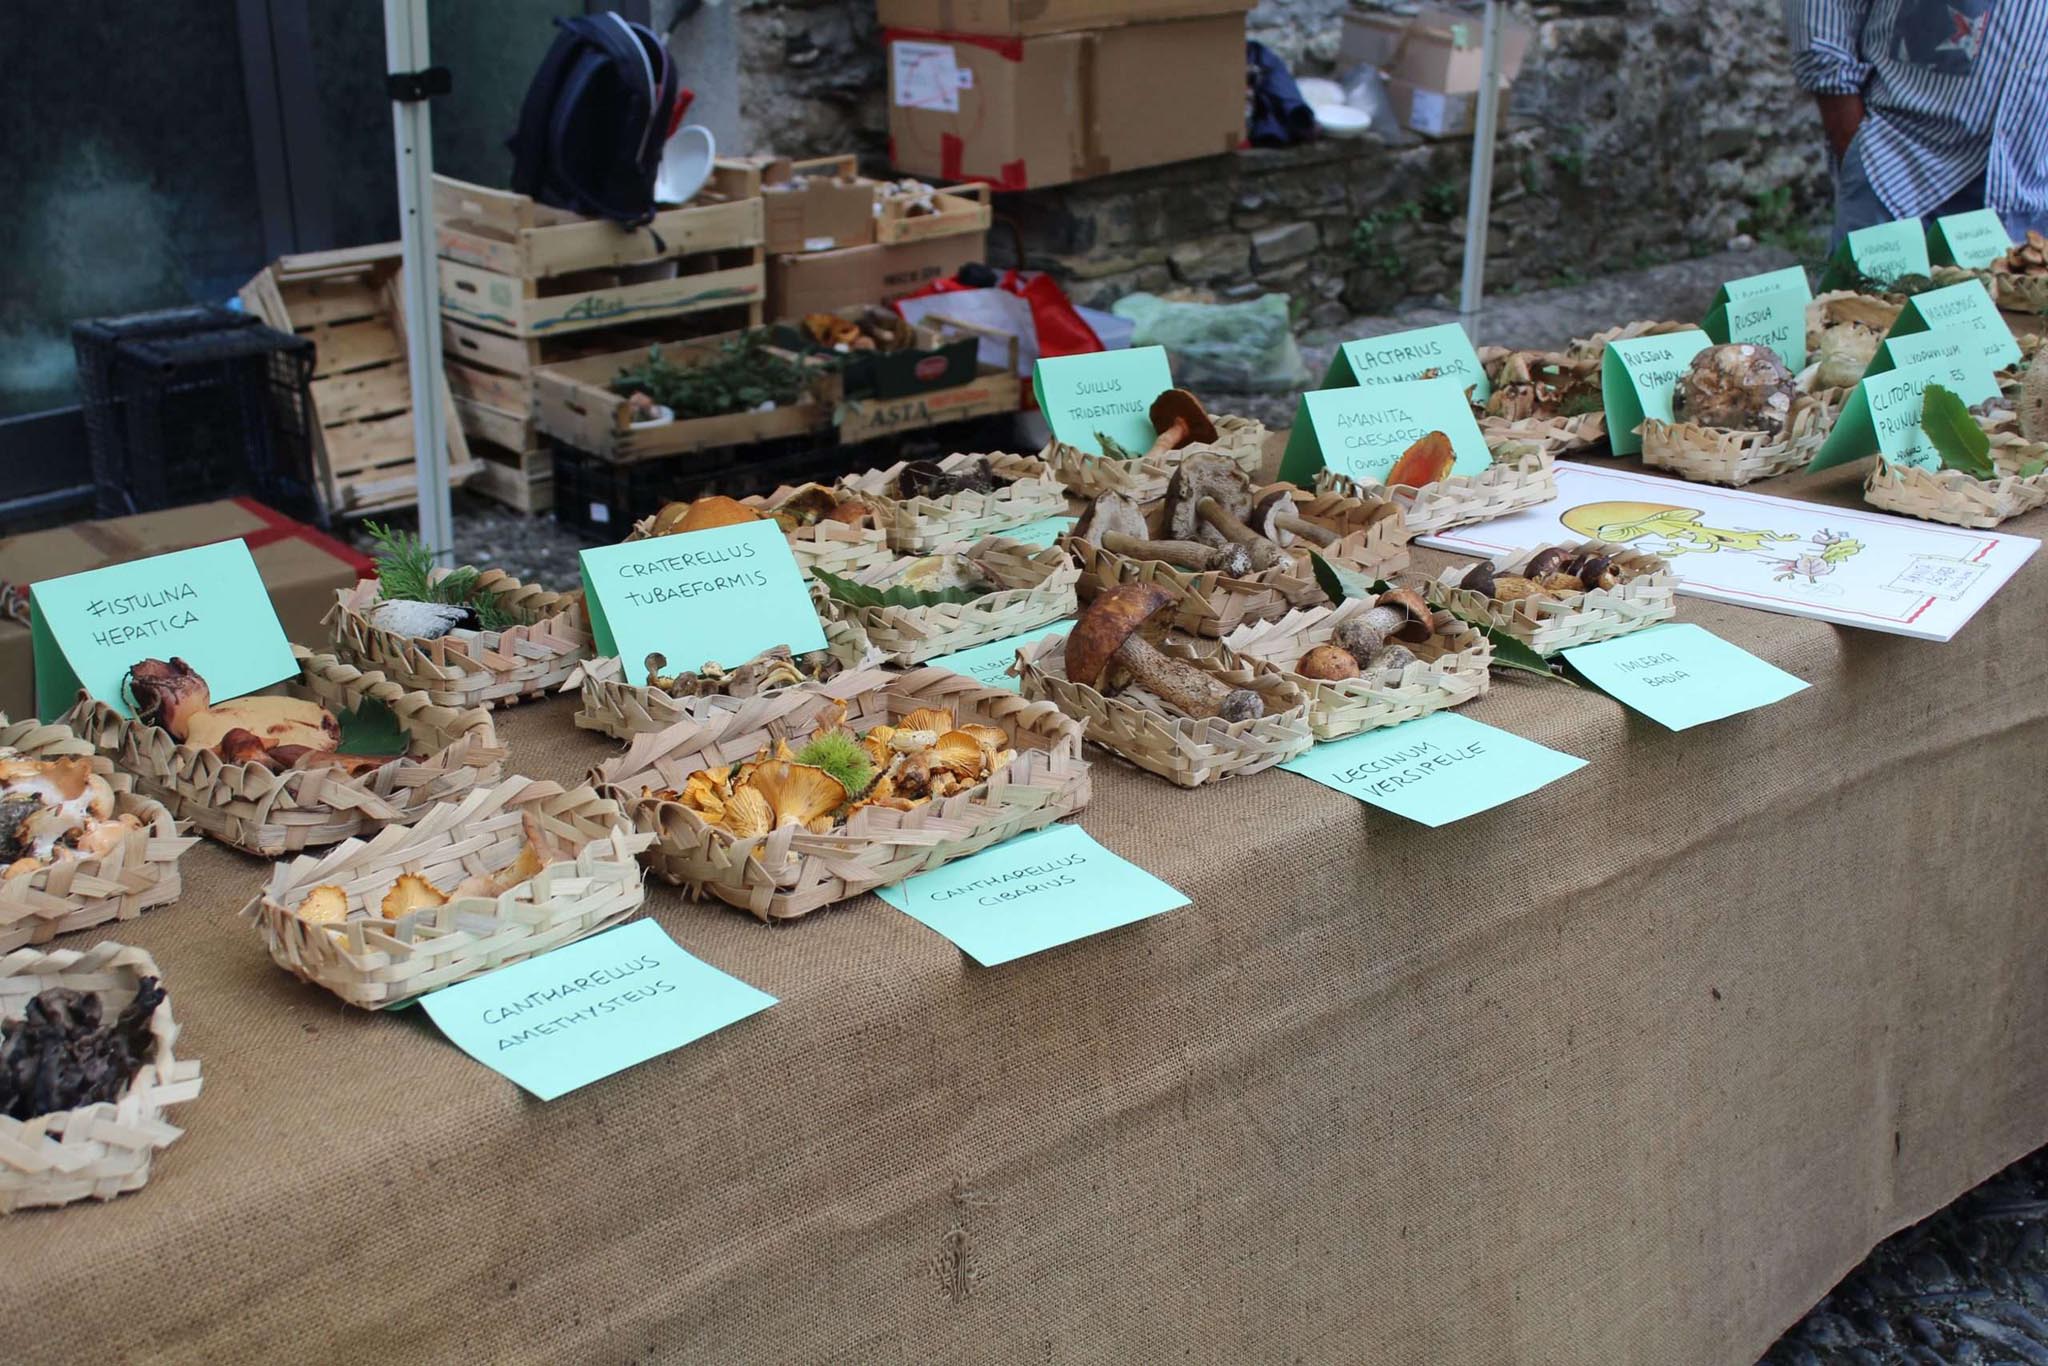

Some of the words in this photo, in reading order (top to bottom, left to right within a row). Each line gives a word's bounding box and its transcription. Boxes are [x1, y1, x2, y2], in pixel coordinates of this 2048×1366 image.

[1354, 341, 1442, 371] LACTARIUS
[1623, 349, 1675, 367] RUSSULA
[1075, 378, 1122, 396] SUILLUS
[1067, 400, 1144, 421] TRIDENTINUS
[1337, 408, 1413, 428] AMANITA
[1344, 427, 1430, 450] CAESAREA
[619, 542, 757, 579] CRATERELLUS
[86, 582, 198, 618] FISTULINA
[625, 570, 768, 607] TUBAEFORMIS
[92, 610, 200, 647] HEPATICA
[1614, 652, 1680, 673] IMLERIA
[1642, 670, 1691, 687] BADIA
[1332, 741, 1441, 784] LECCINUM
[1362, 741, 1487, 797] VERSIPELLE
[930, 853, 1087, 902] CANTHARELLUS
[978, 874, 1076, 907] CIBARIUS
[482, 954, 661, 1025] CANTHARELLUS
[499, 979, 676, 1051] AMETHYSTEUS
